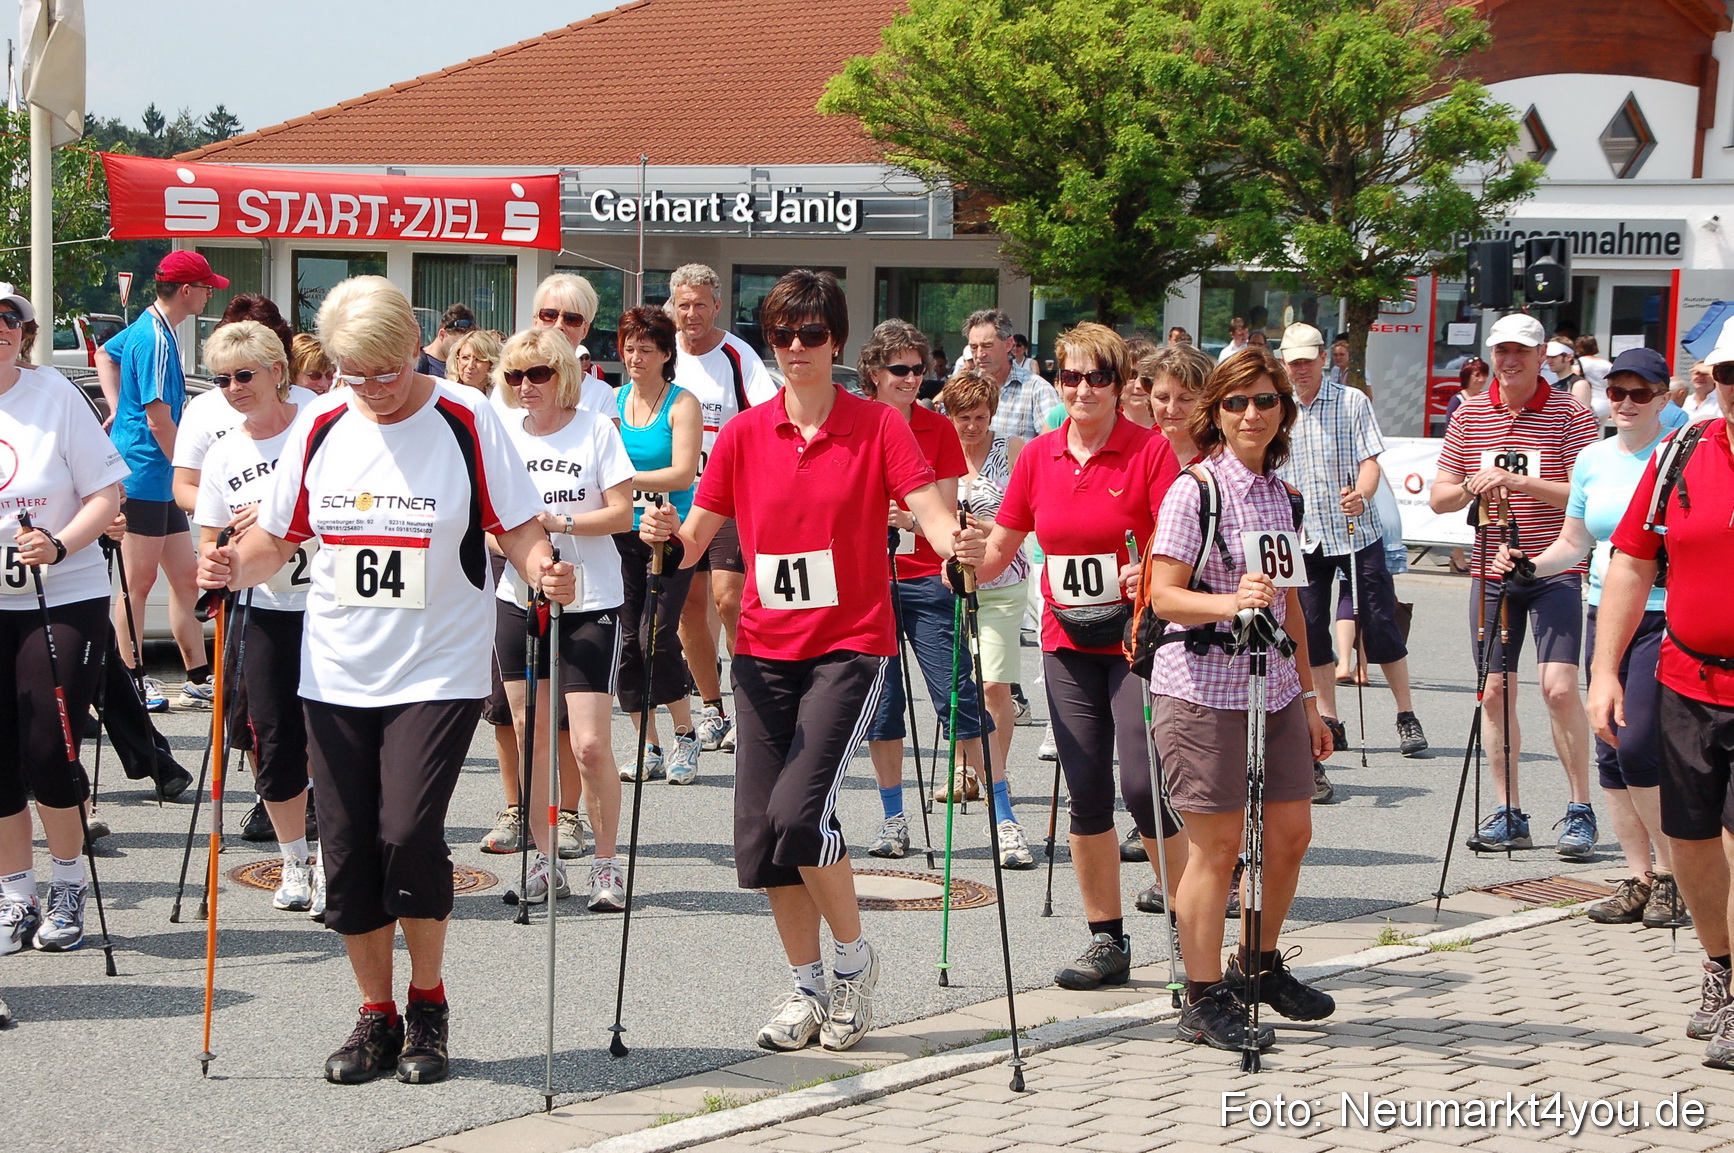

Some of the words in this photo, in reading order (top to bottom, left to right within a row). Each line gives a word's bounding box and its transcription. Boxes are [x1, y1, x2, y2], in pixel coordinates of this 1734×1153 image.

[236, 188, 489, 240] START+ZIEL
[590, 188, 722, 223] Gerhart
[732, 192, 755, 223] &
[766, 186, 862, 233] Jänig
[1370, 324, 1423, 333] SEAT
[701, 402, 722, 412] NER
[526, 458, 582, 478] RGER
[0, 501, 11, 509] IT
[543, 488, 586, 504] GIRLS
[0, 545, 27, 589] 5
[356, 549, 404, 598] 64
[1062, 557, 1105, 597] 40
[1257, 534, 1294, 579] 69
[773, 557, 811, 602] 41
